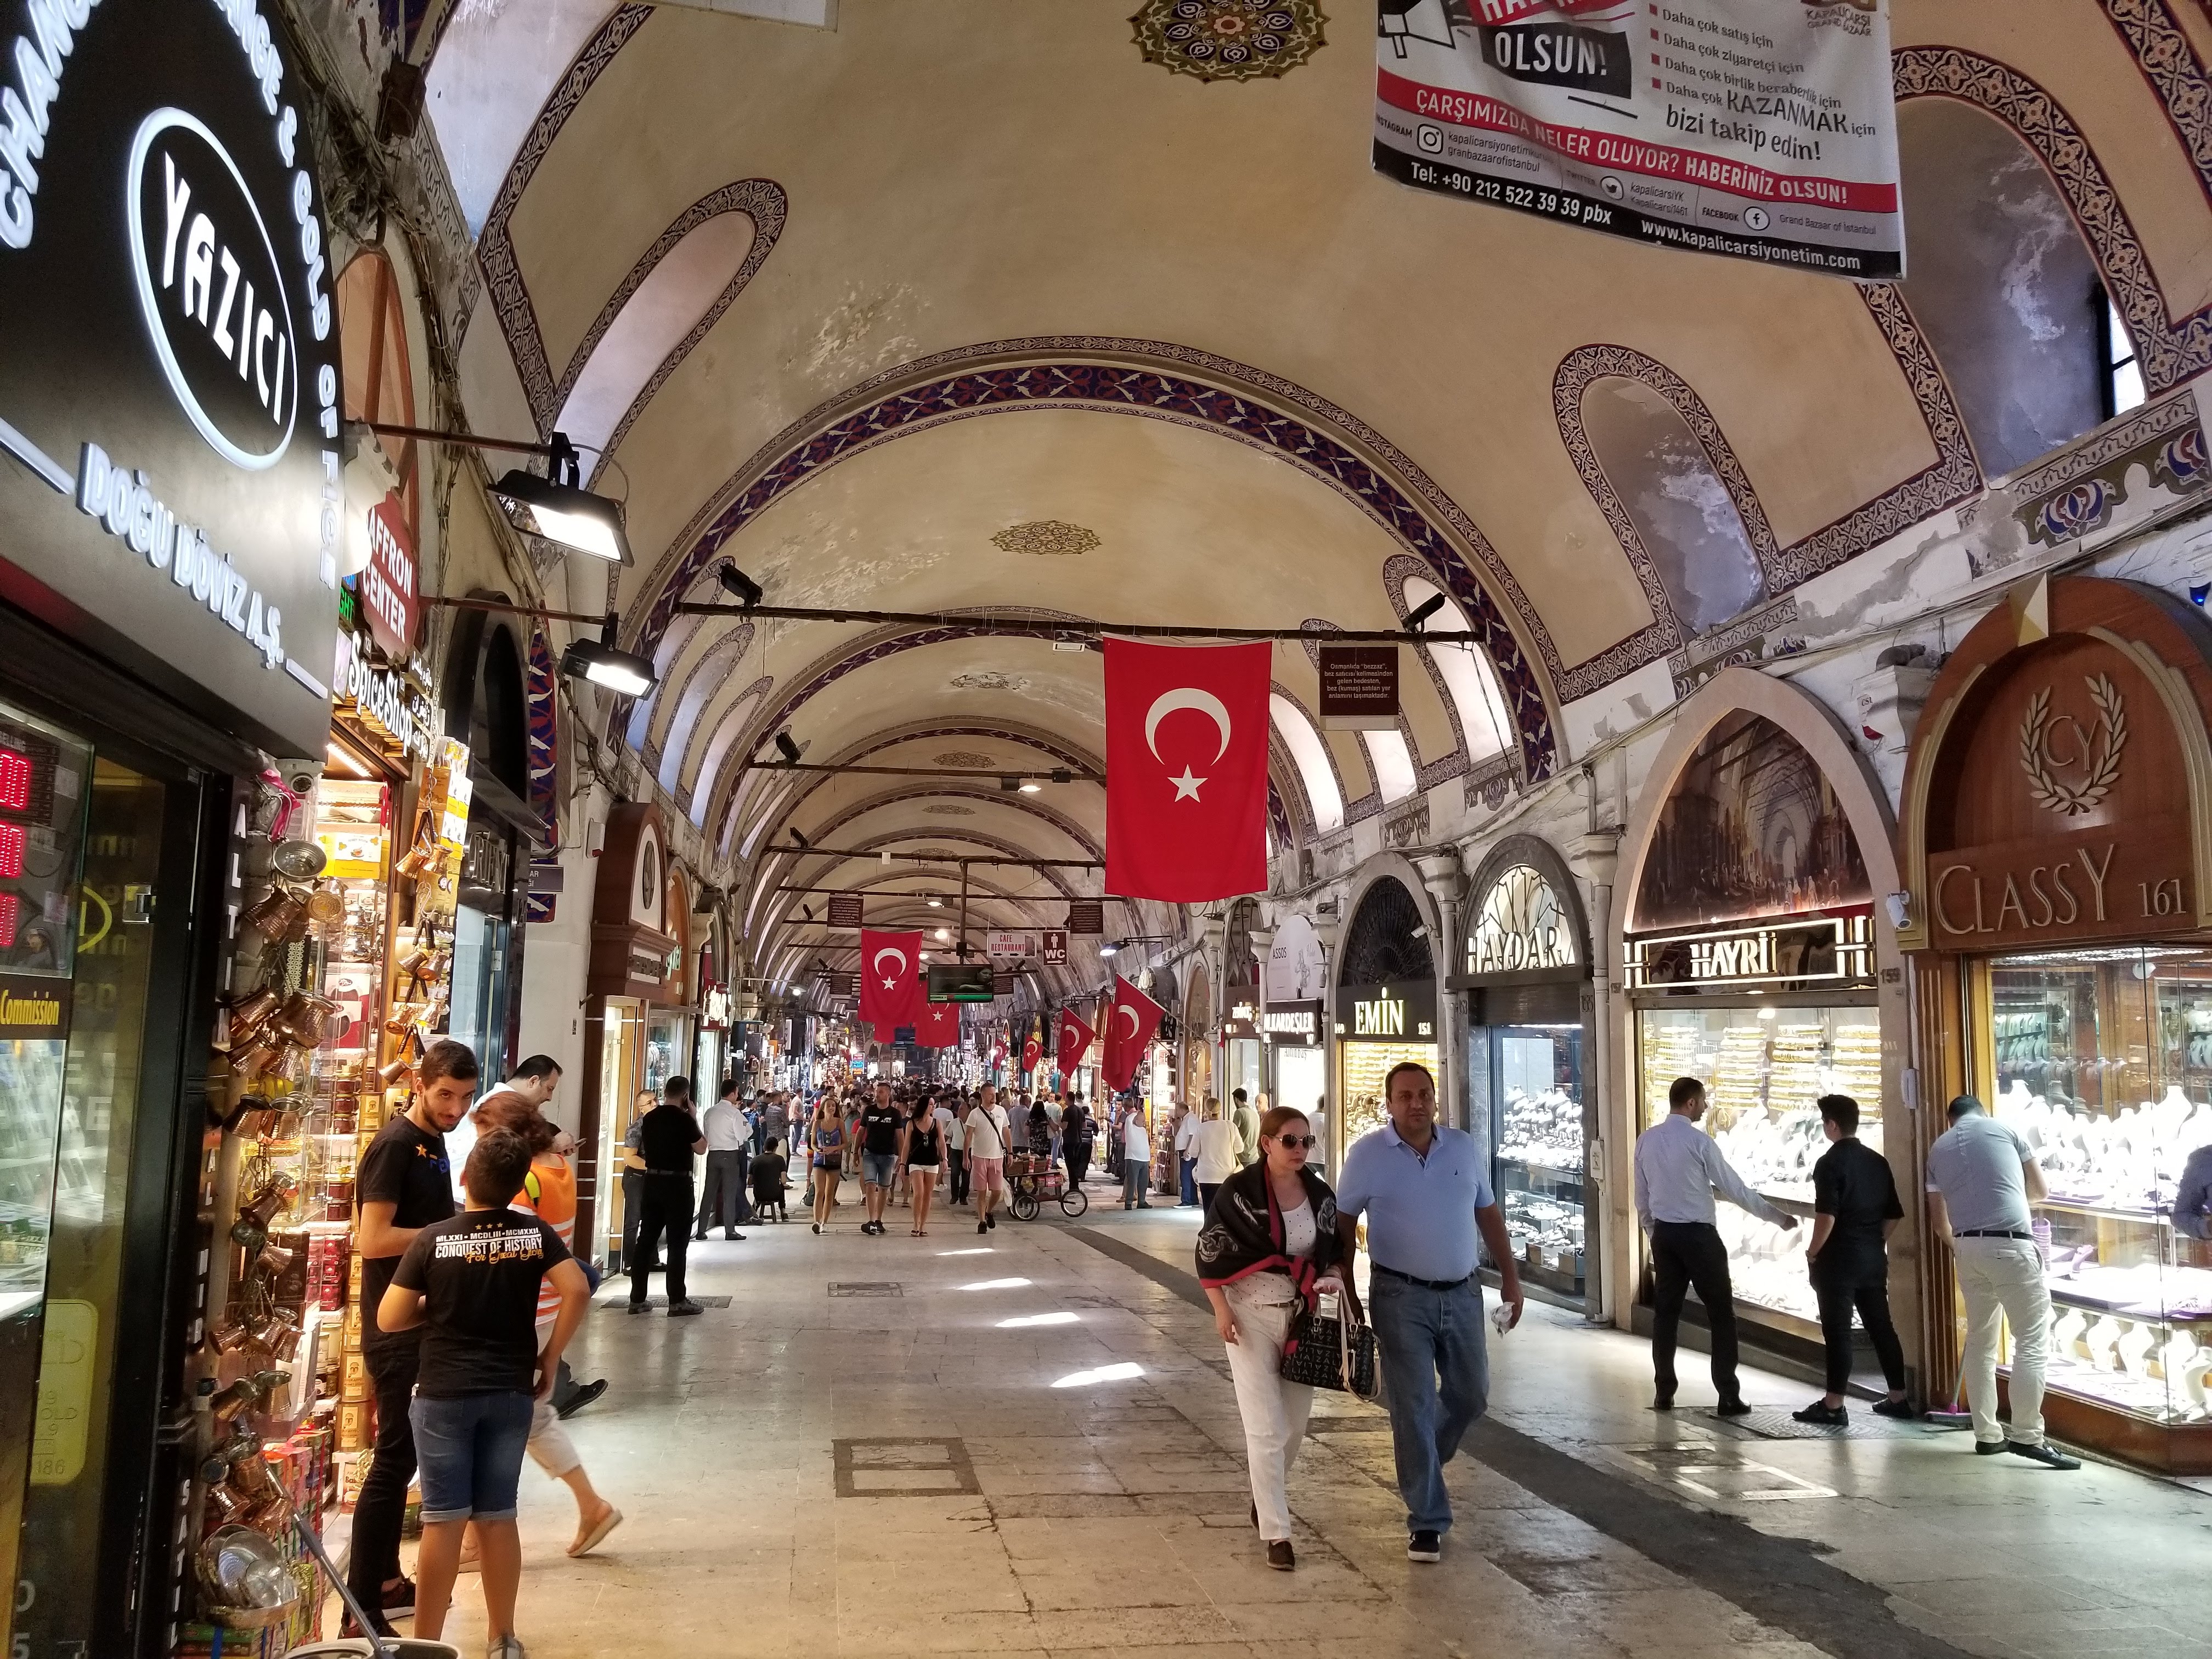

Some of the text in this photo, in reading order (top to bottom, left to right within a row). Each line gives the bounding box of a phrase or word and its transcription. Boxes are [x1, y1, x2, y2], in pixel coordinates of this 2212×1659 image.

[1662, 9, 1773, 48] Daha çok satış için
[1494, 31, 1609, 76] OLSUN!
[1664, 33, 1804, 75] Daha çok ziyaretçi için
[1665, 57, 1841, 108] Daha çok birlik beraberlik için
[1666, 82, 1876, 136] Daha çok KAZANMAK için
[1666, 104, 1821, 160] bizi takip edin!
[1417, 89, 1848, 204] ÇARŞIMIZDA NELER OLUYOR? HABERİNİZ OLSUN!
[1448, 146, 1540, 172] granbazaarofistanbul
[1412, 162, 1612, 224] Tel: +90 212 522 39 39 pbx
[1702, 207, 1739, 222] FACEBOOK
[1641, 219, 1861, 270] www.kapalicarsiyonetim.com
[1779, 213, 1804, 225] Grand
[1805, 216, 1832, 231] Bazaar
[1833, 222, 1842, 232] of
[294, 169, 330, 341] GOLD
[162, 150, 285, 426] YAZICI
[366, 505, 413, 599] AFFRON
[362, 563, 406, 644] CENTER
[348, 630, 385, 722] Spice
[384, 670, 412, 758] Shop
[1935, 844, 2187, 935] CLASSY 161
[991, 944, 1025, 952] RESTAURANT
[1000, 934, 1013, 943] CAFE
[1045, 949, 1065, 959] WC
[1273, 947, 1287, 959] ASSOS
[1468, 926, 1563, 975] HAYDAR
[1690, 932, 1771, 978] HAYRİ
[1, 991, 60, 1025] Commission
[1354, 987, 1404, 1035] EMİN
[1418, 1022, 1432, 1035] 151
[436, 1237, 542, 1259] CONQUEST OF HISTORY
[466, 1251, 487, 1263] For
